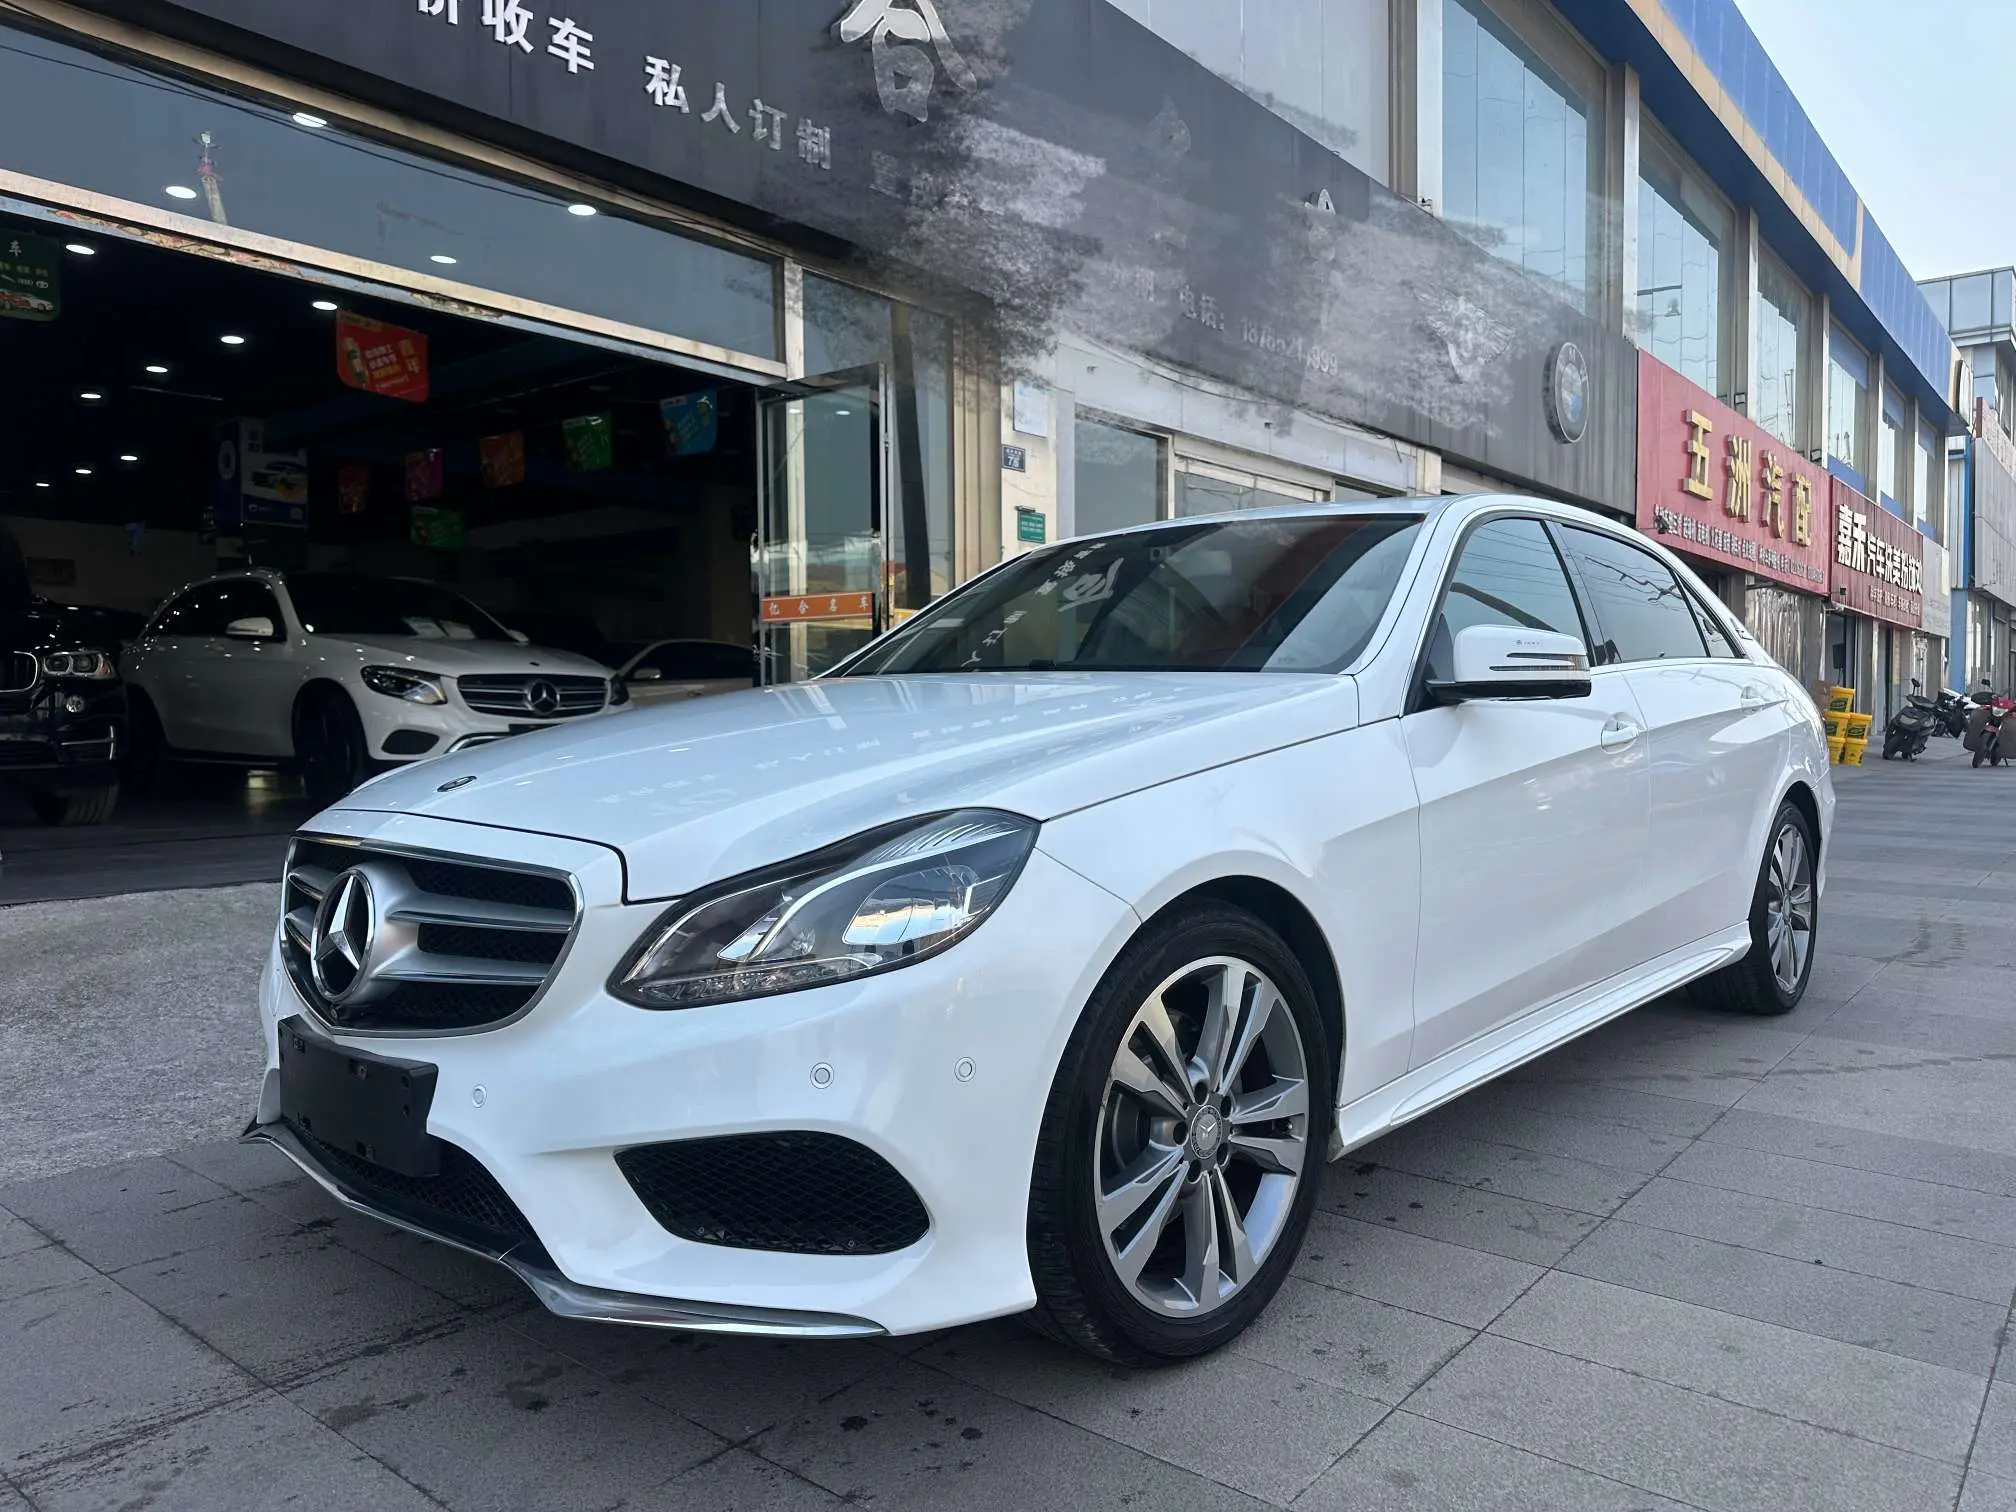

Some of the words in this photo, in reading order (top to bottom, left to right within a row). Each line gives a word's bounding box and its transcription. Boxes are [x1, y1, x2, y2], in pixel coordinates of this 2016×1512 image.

[644, 55, 832, 170] 私人订制
[1683, 408, 1813, 547] 五洲汽配
[1838, 503, 1867, 573] 嘉禾
